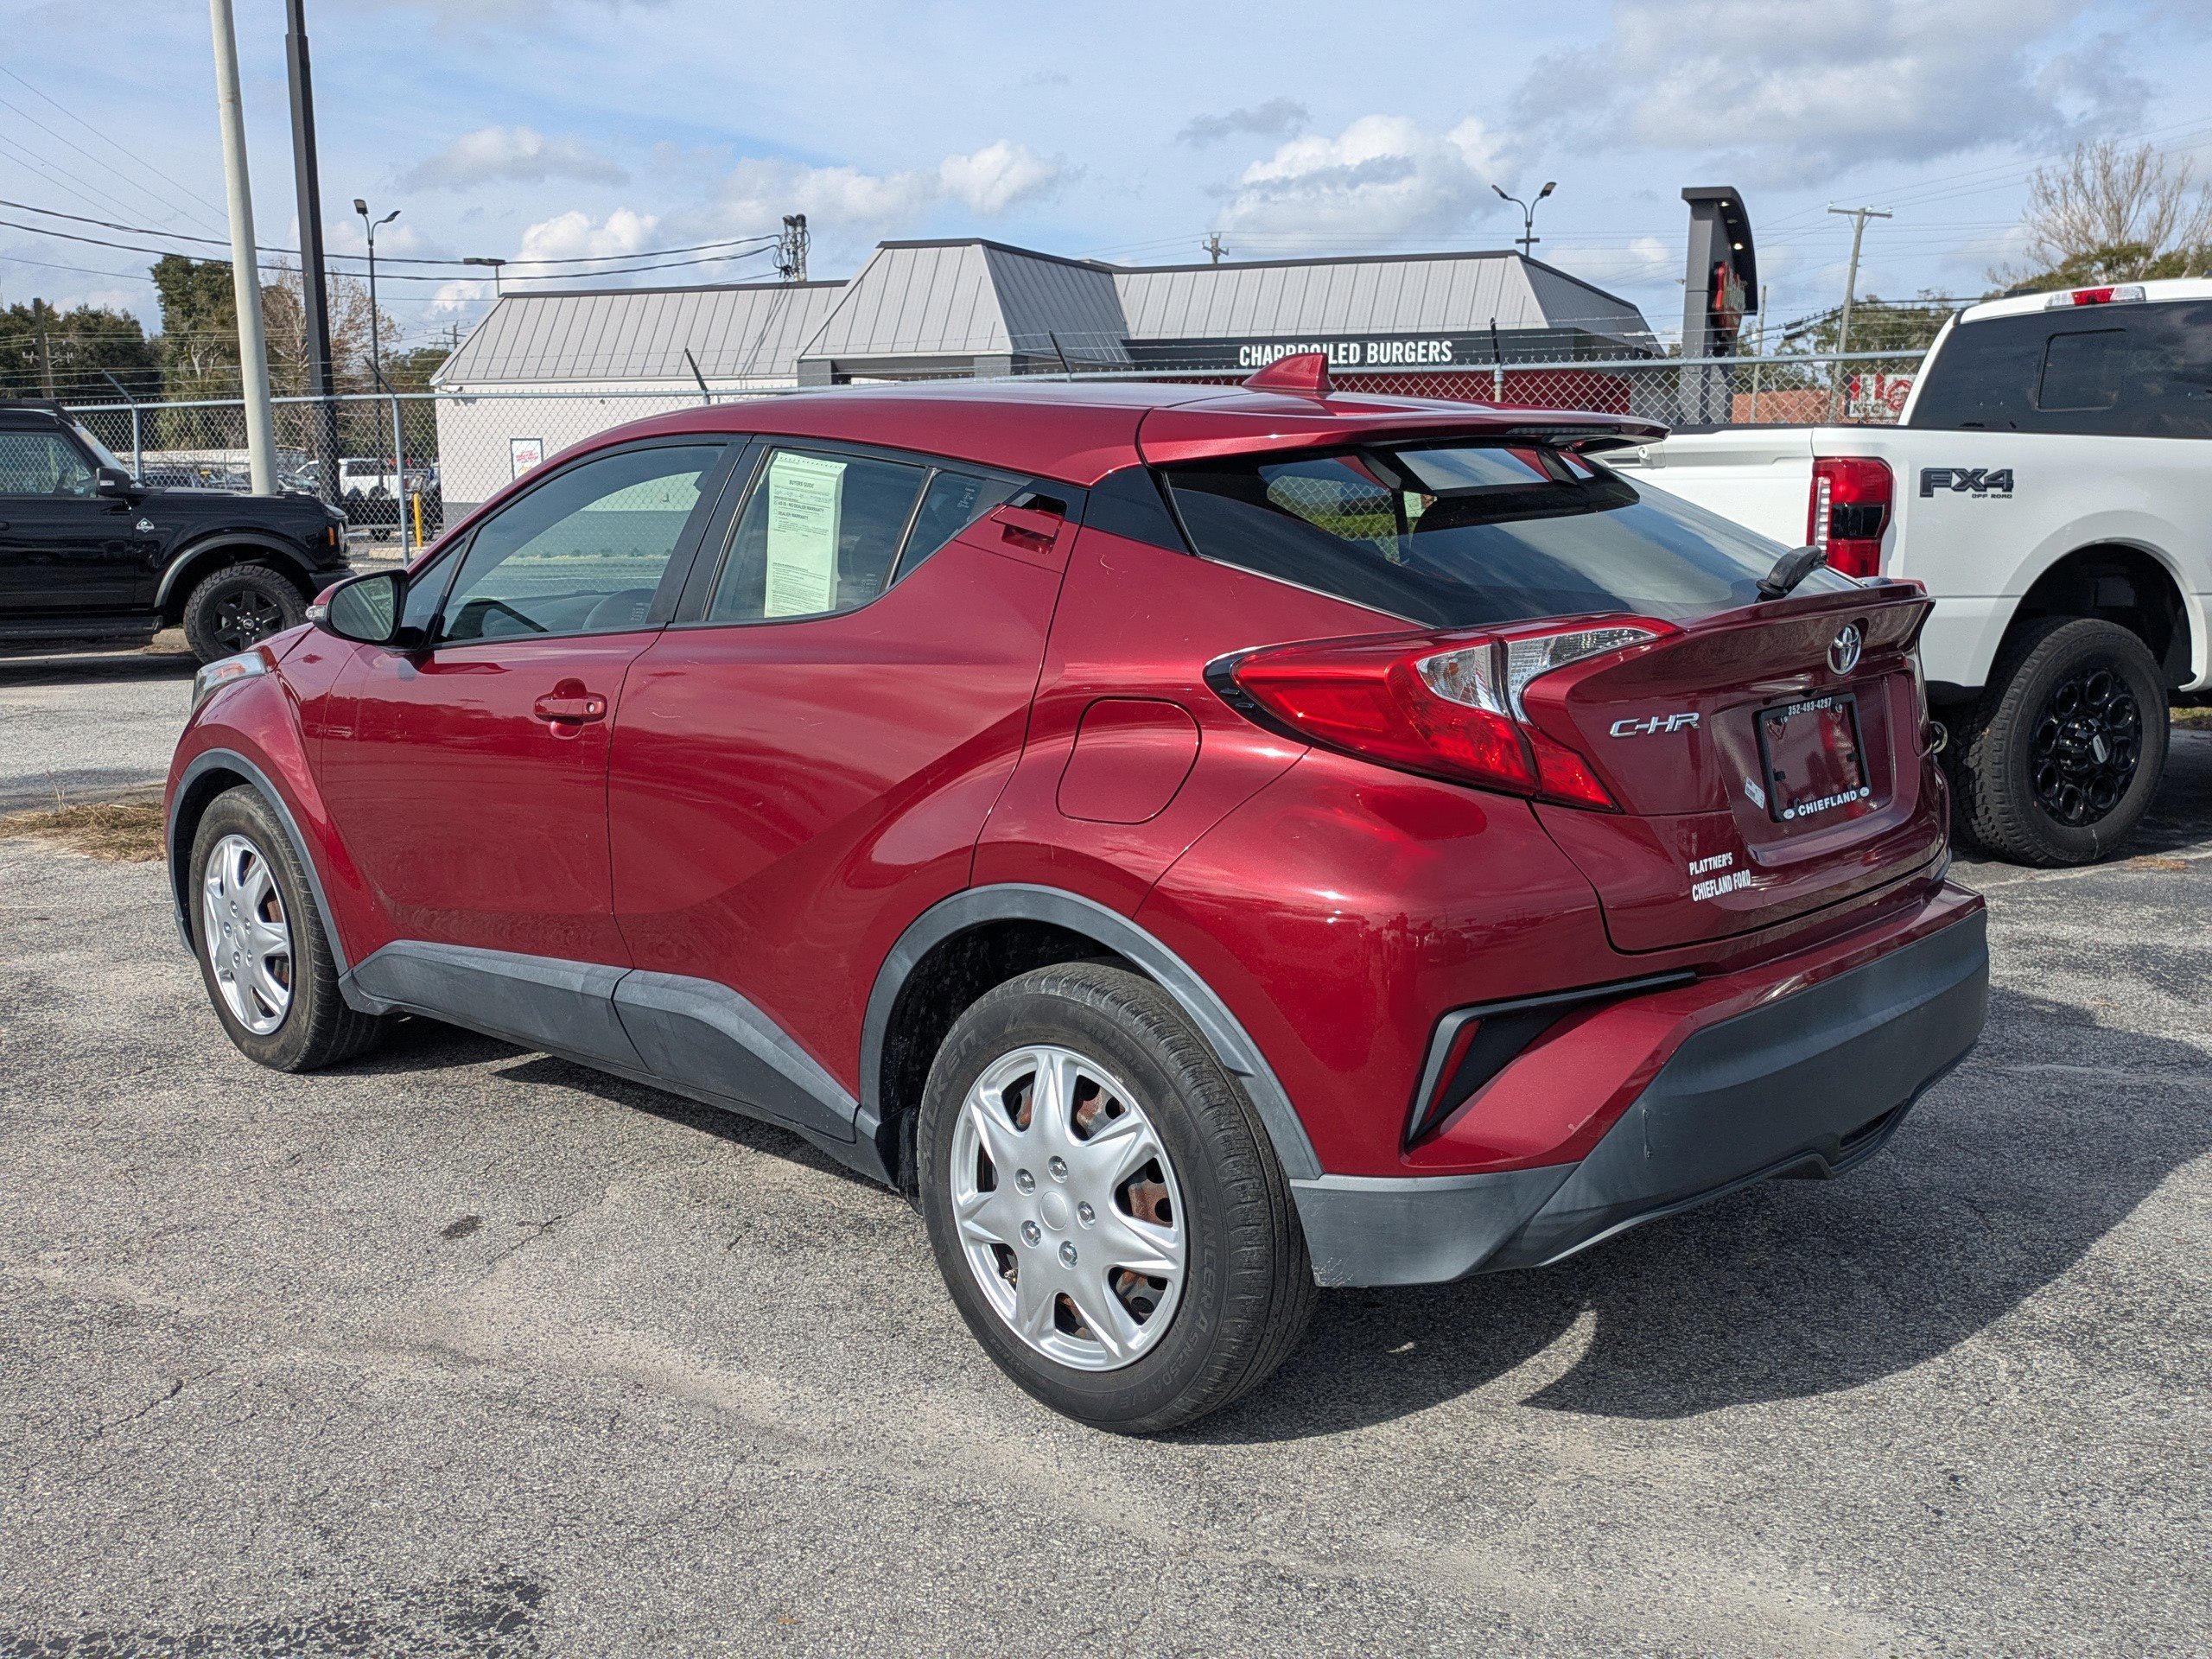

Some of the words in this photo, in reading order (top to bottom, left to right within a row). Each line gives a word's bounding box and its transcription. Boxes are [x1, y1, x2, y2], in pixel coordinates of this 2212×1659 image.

[1367, 340, 1452, 364] BURGERS
[1919, 467, 2014, 498] FX4
[1609, 712, 1701, 738] C-HR
[1797, 790, 1857, 817] CHIEFLAND
[1688, 852, 1733, 876] PLATTNER'S
[1692, 874, 1733, 902] CHIEFLAND
[1732, 868, 1751, 890] FORD
[1188, 1183, 1220, 1334] SINCERA
